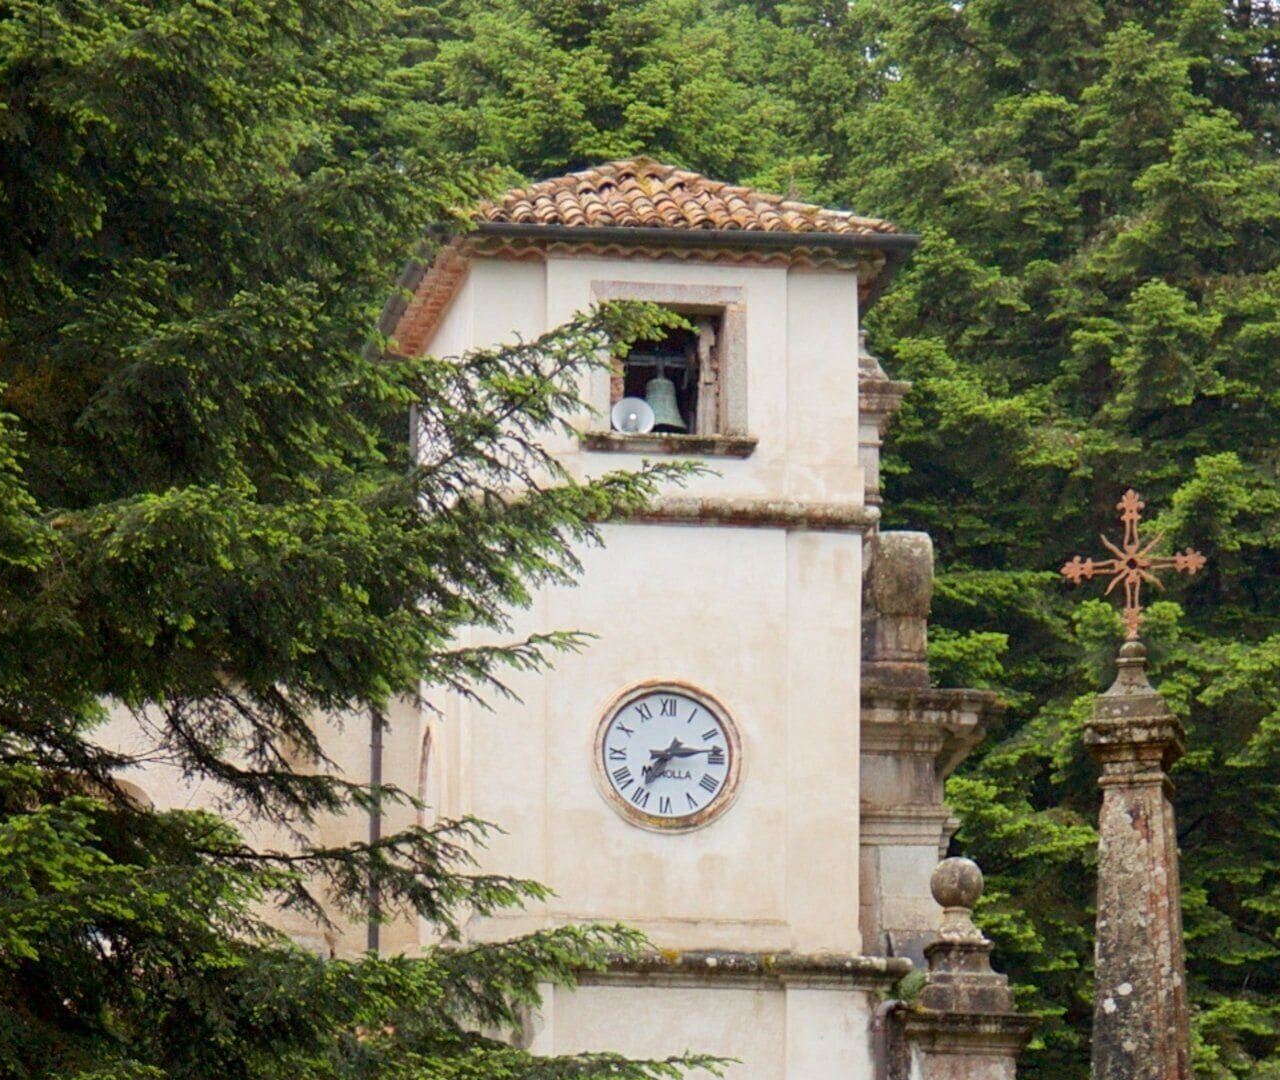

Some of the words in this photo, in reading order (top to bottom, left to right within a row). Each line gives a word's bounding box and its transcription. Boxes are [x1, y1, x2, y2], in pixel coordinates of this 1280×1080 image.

[634, 702, 653, 723] XI
[659, 698, 677, 717] XII
[615, 722, 634, 738] X
[701, 728, 719, 741] II
[609, 747, 626, 761] IX
[685, 792, 698, 809] V
